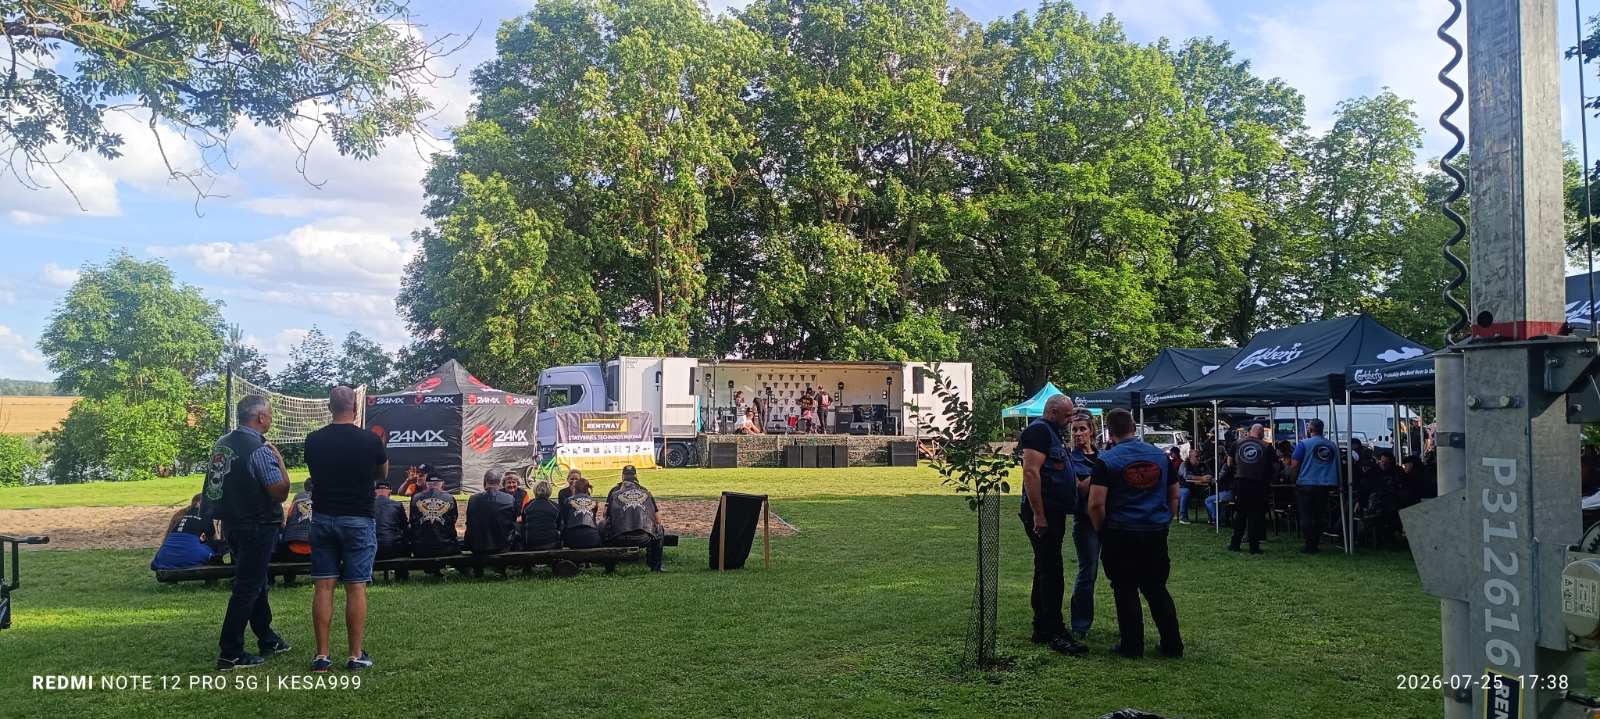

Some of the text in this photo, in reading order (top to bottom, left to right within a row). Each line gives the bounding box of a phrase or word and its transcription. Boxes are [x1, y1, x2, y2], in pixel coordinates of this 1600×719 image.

[1354, 369, 1383, 385] Carlsberg
[376, 397, 405, 405] 24MX
[424, 396, 454, 405] 24MX
[477, 397, 500, 405] 24MX
[513, 397, 534, 406] 24MX
[389, 430, 446, 443] 24MX
[494, 430, 527, 442] 24MX
[1481, 457, 1521, 667] P312616
